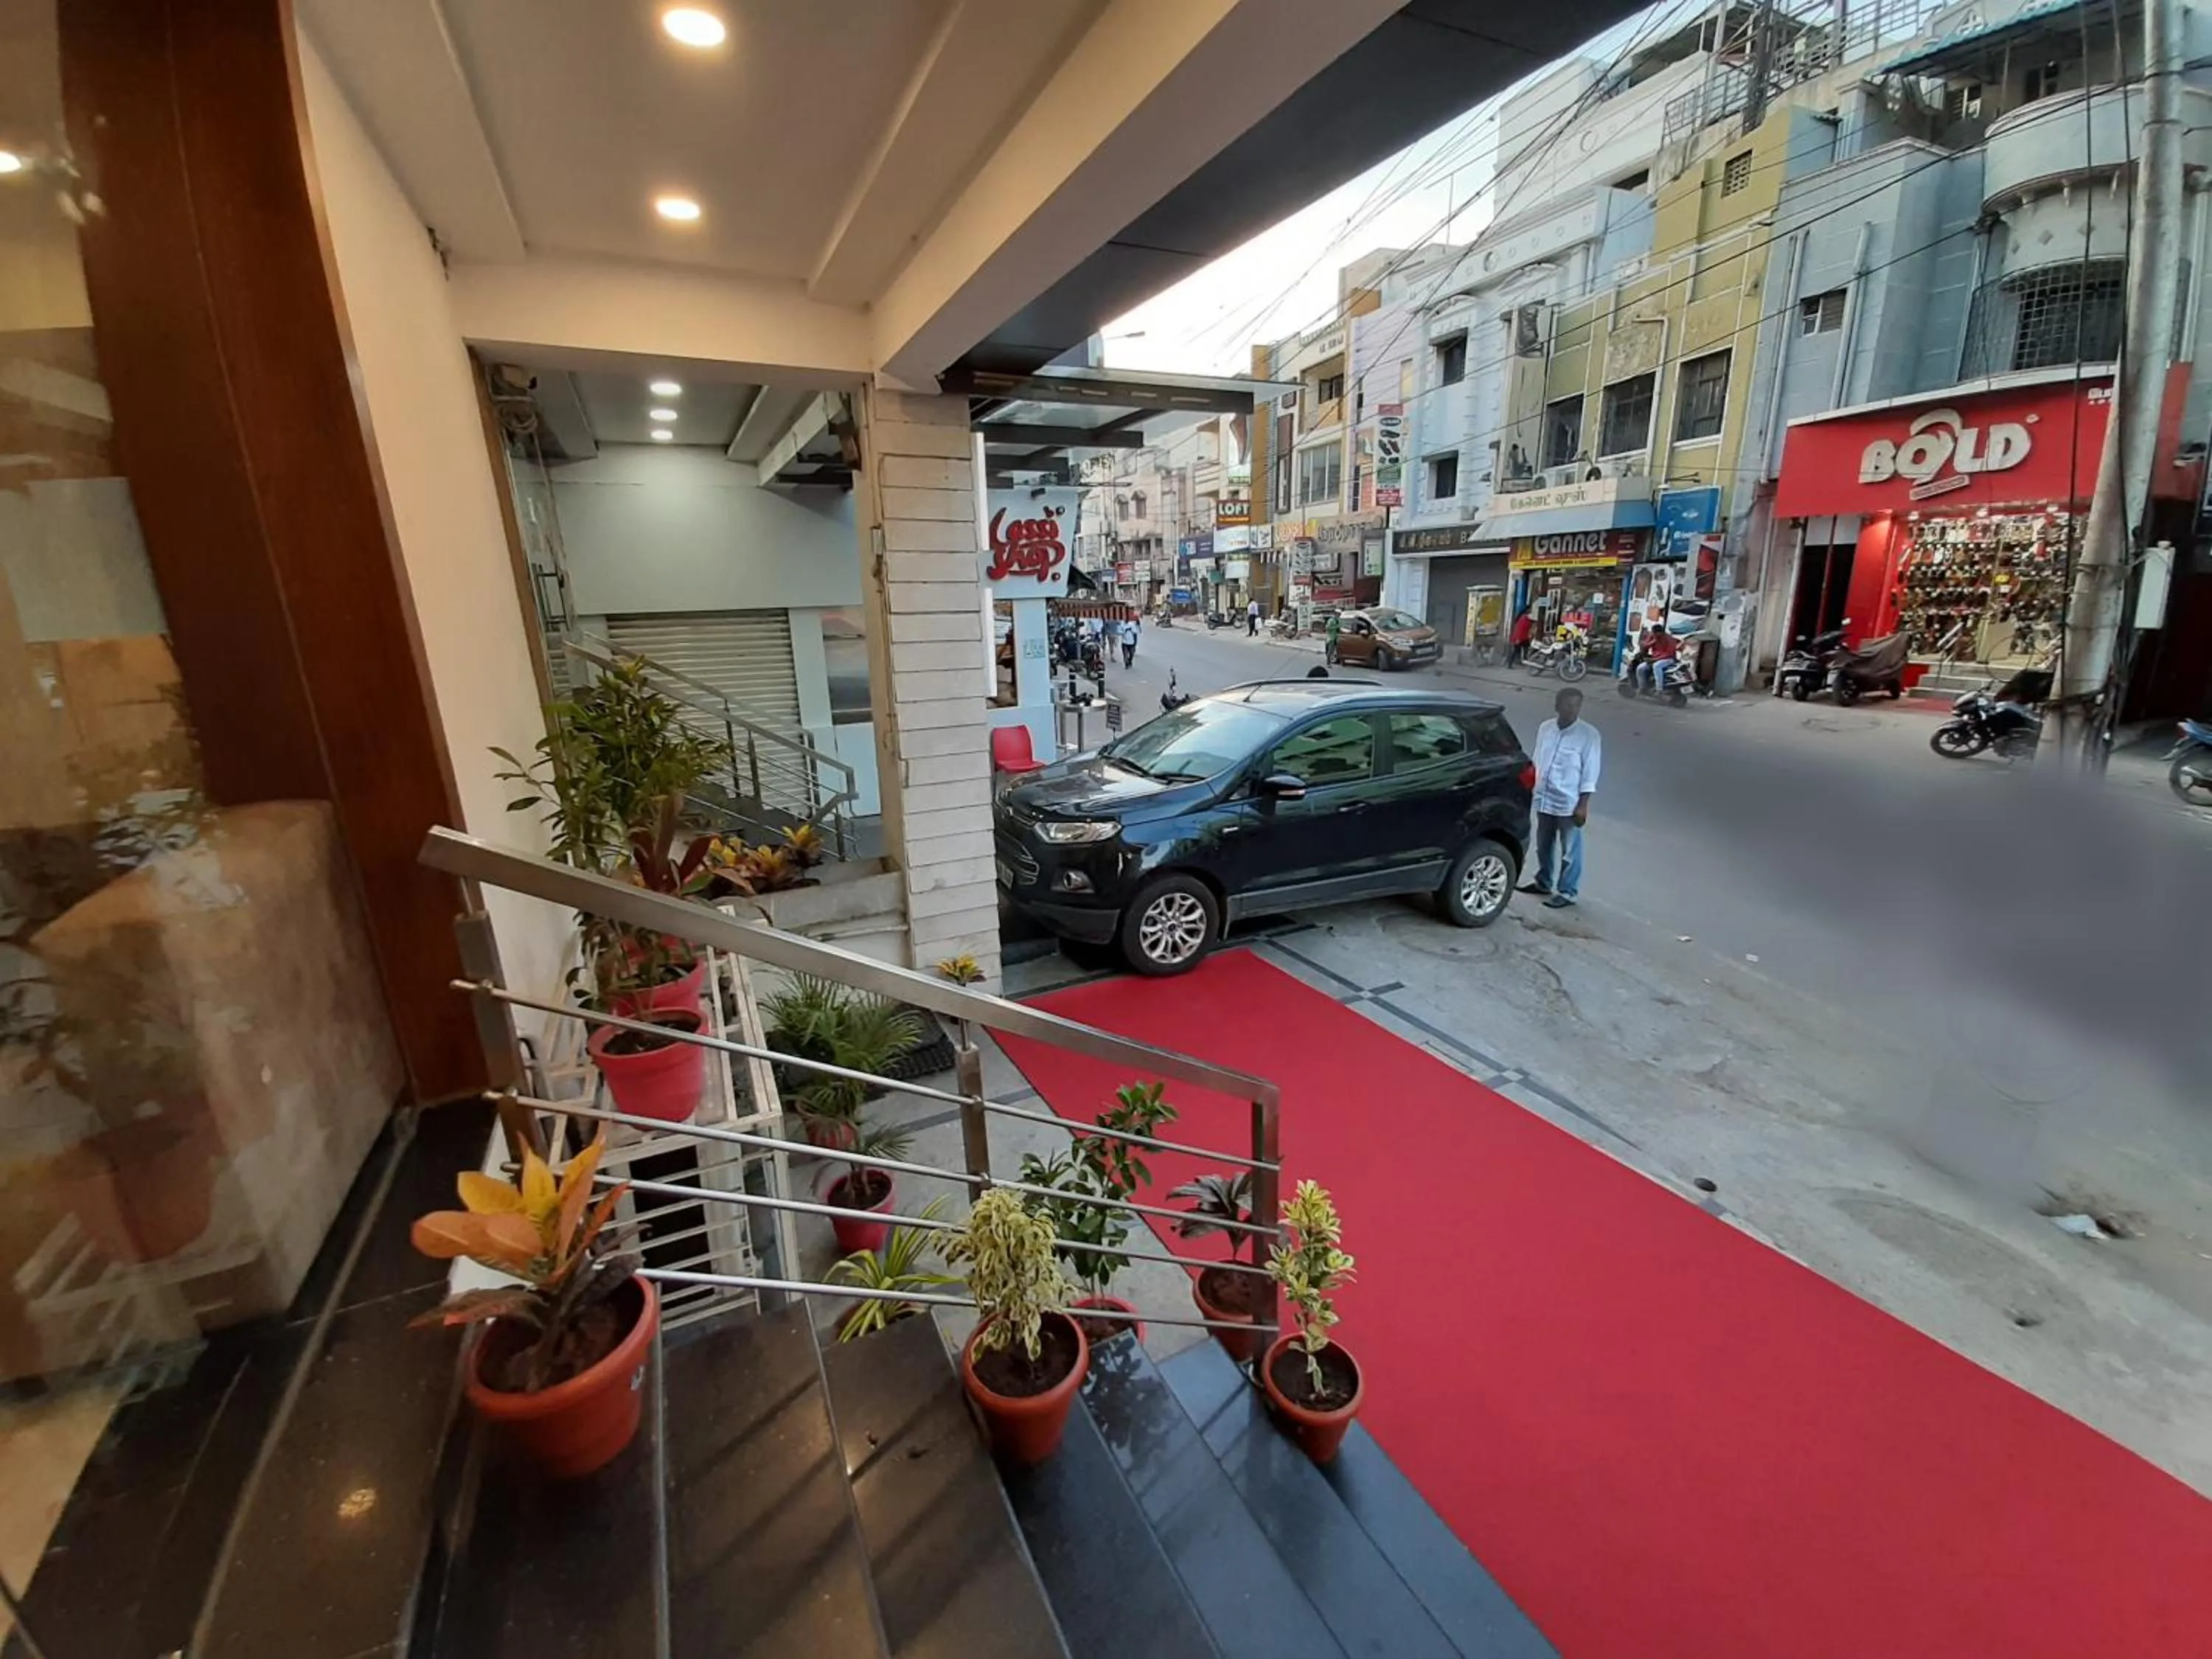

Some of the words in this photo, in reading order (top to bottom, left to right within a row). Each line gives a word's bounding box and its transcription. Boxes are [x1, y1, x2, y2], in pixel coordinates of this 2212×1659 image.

[1857, 408, 2031, 484] BOLD
[1219, 502, 1250, 515] LOFT
[1534, 530, 1607, 554] Gannet
